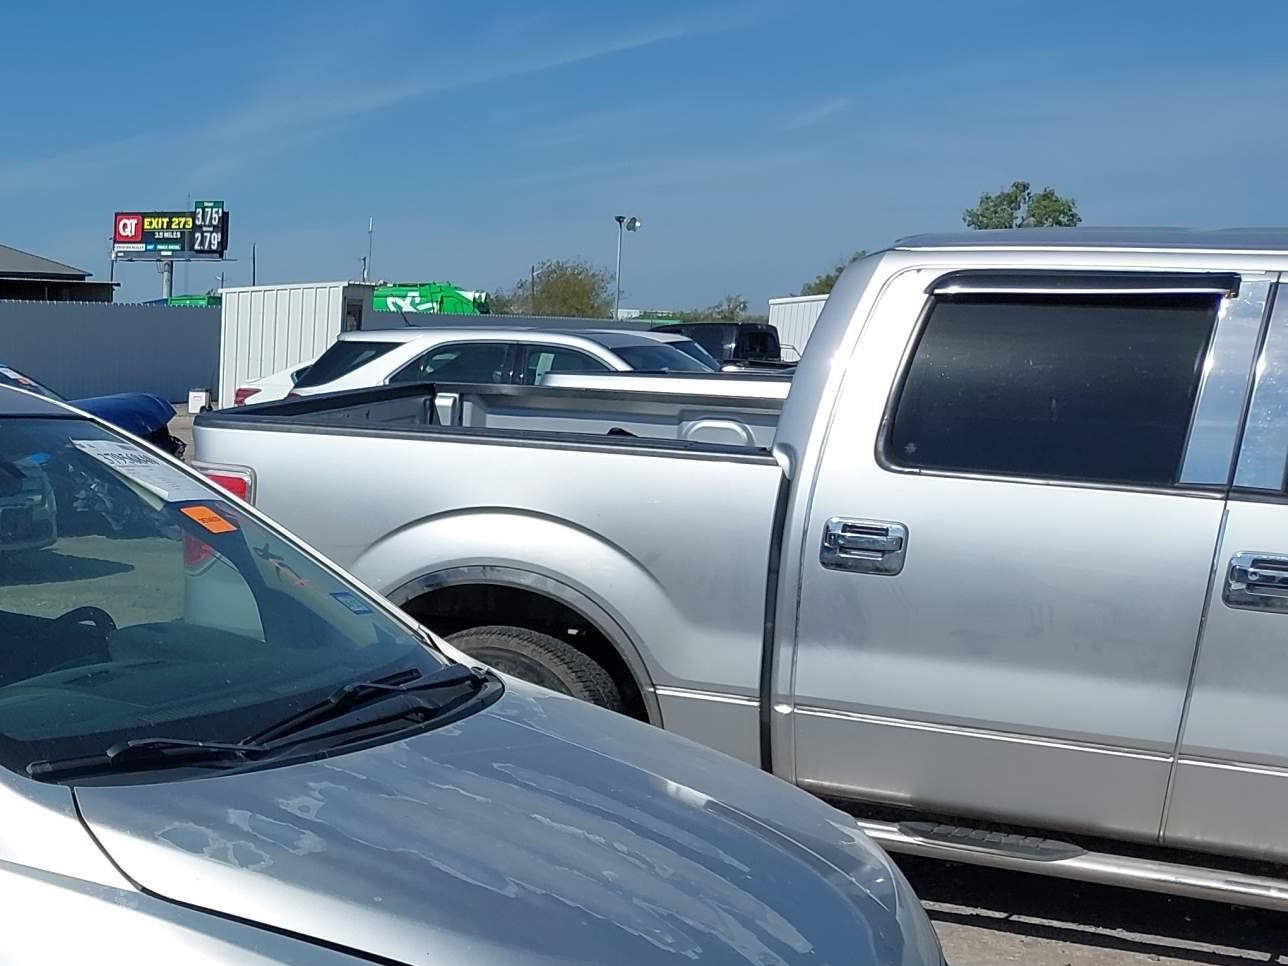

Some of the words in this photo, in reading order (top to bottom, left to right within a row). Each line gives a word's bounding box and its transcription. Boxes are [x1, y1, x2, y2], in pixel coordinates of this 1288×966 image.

[118, 218, 137, 237] QT
[143, 217, 169, 229] EXIT
[171, 217, 193, 229] 273
